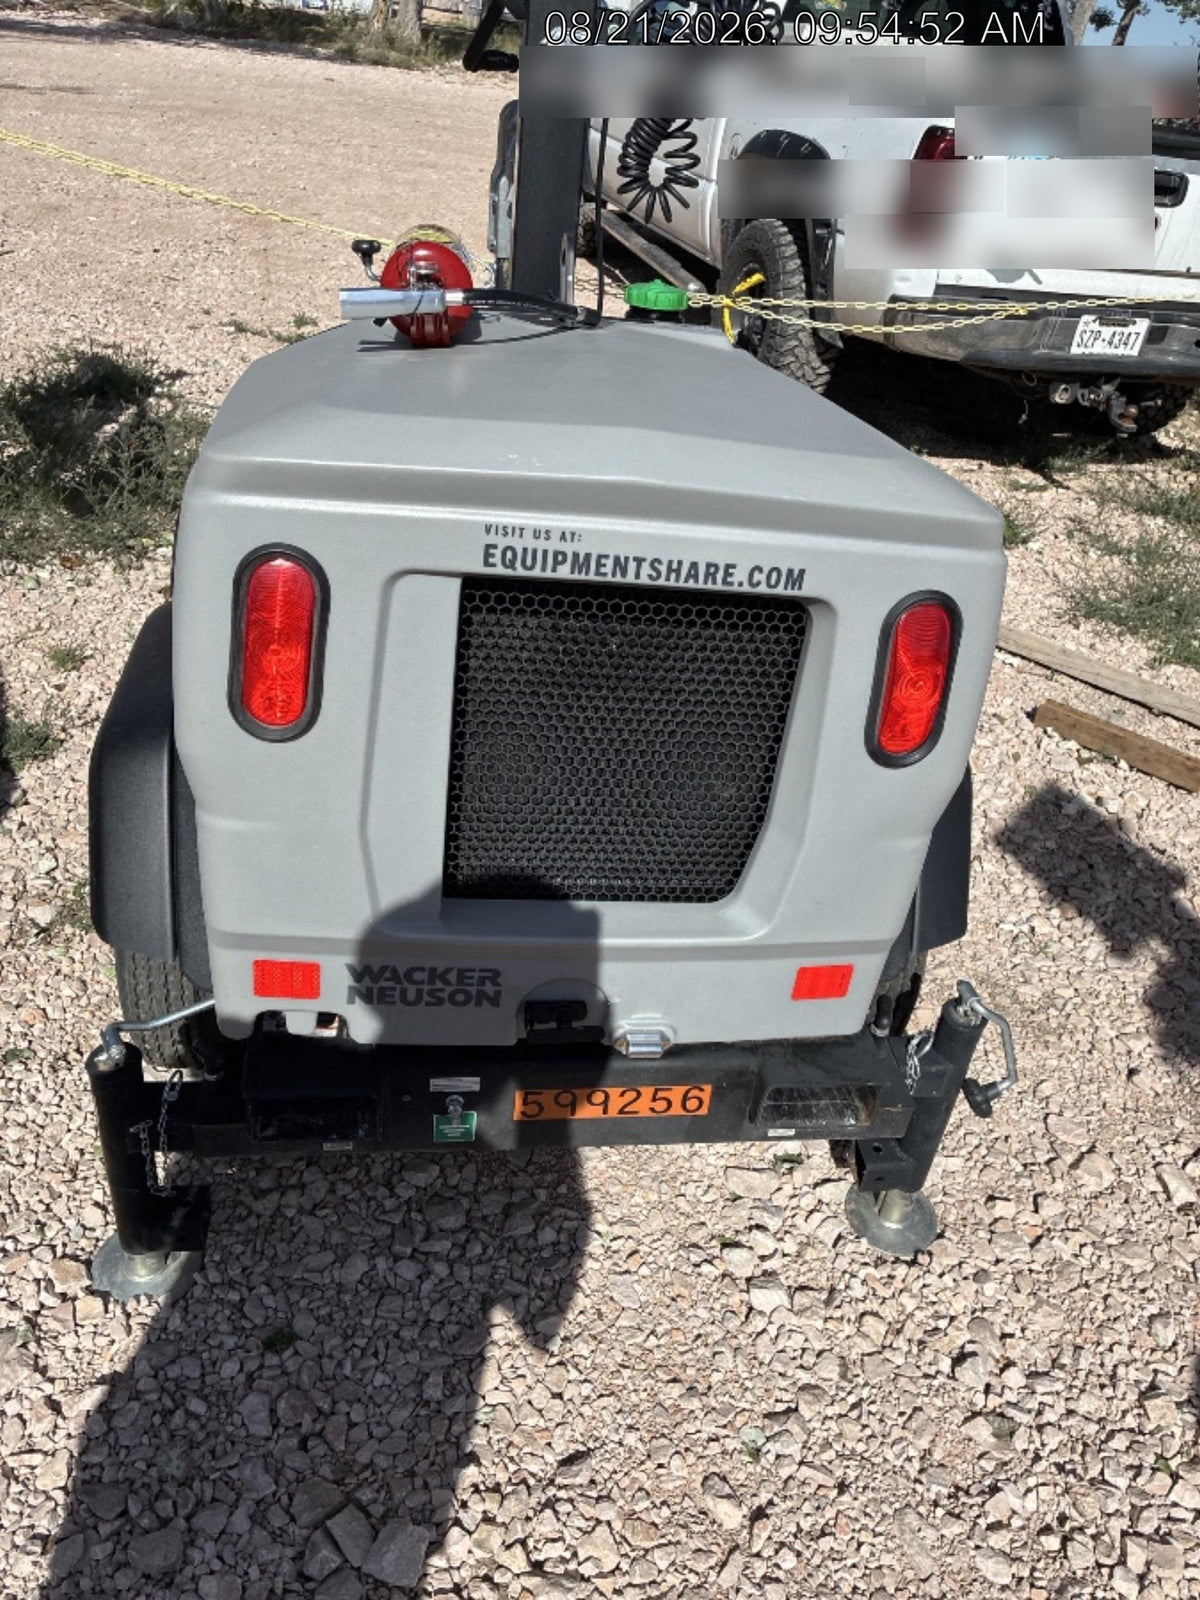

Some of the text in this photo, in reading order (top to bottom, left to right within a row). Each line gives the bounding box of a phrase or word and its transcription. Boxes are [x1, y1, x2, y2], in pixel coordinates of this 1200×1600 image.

[484, 523, 582, 543] VISIT US AT:
[483, 543, 806, 591] EQUIPMENTSHARE.COM
[345, 963, 502, 988] WACKER
[346, 986, 502, 1008] NEUSON
[520, 1086, 704, 1118] 599256
